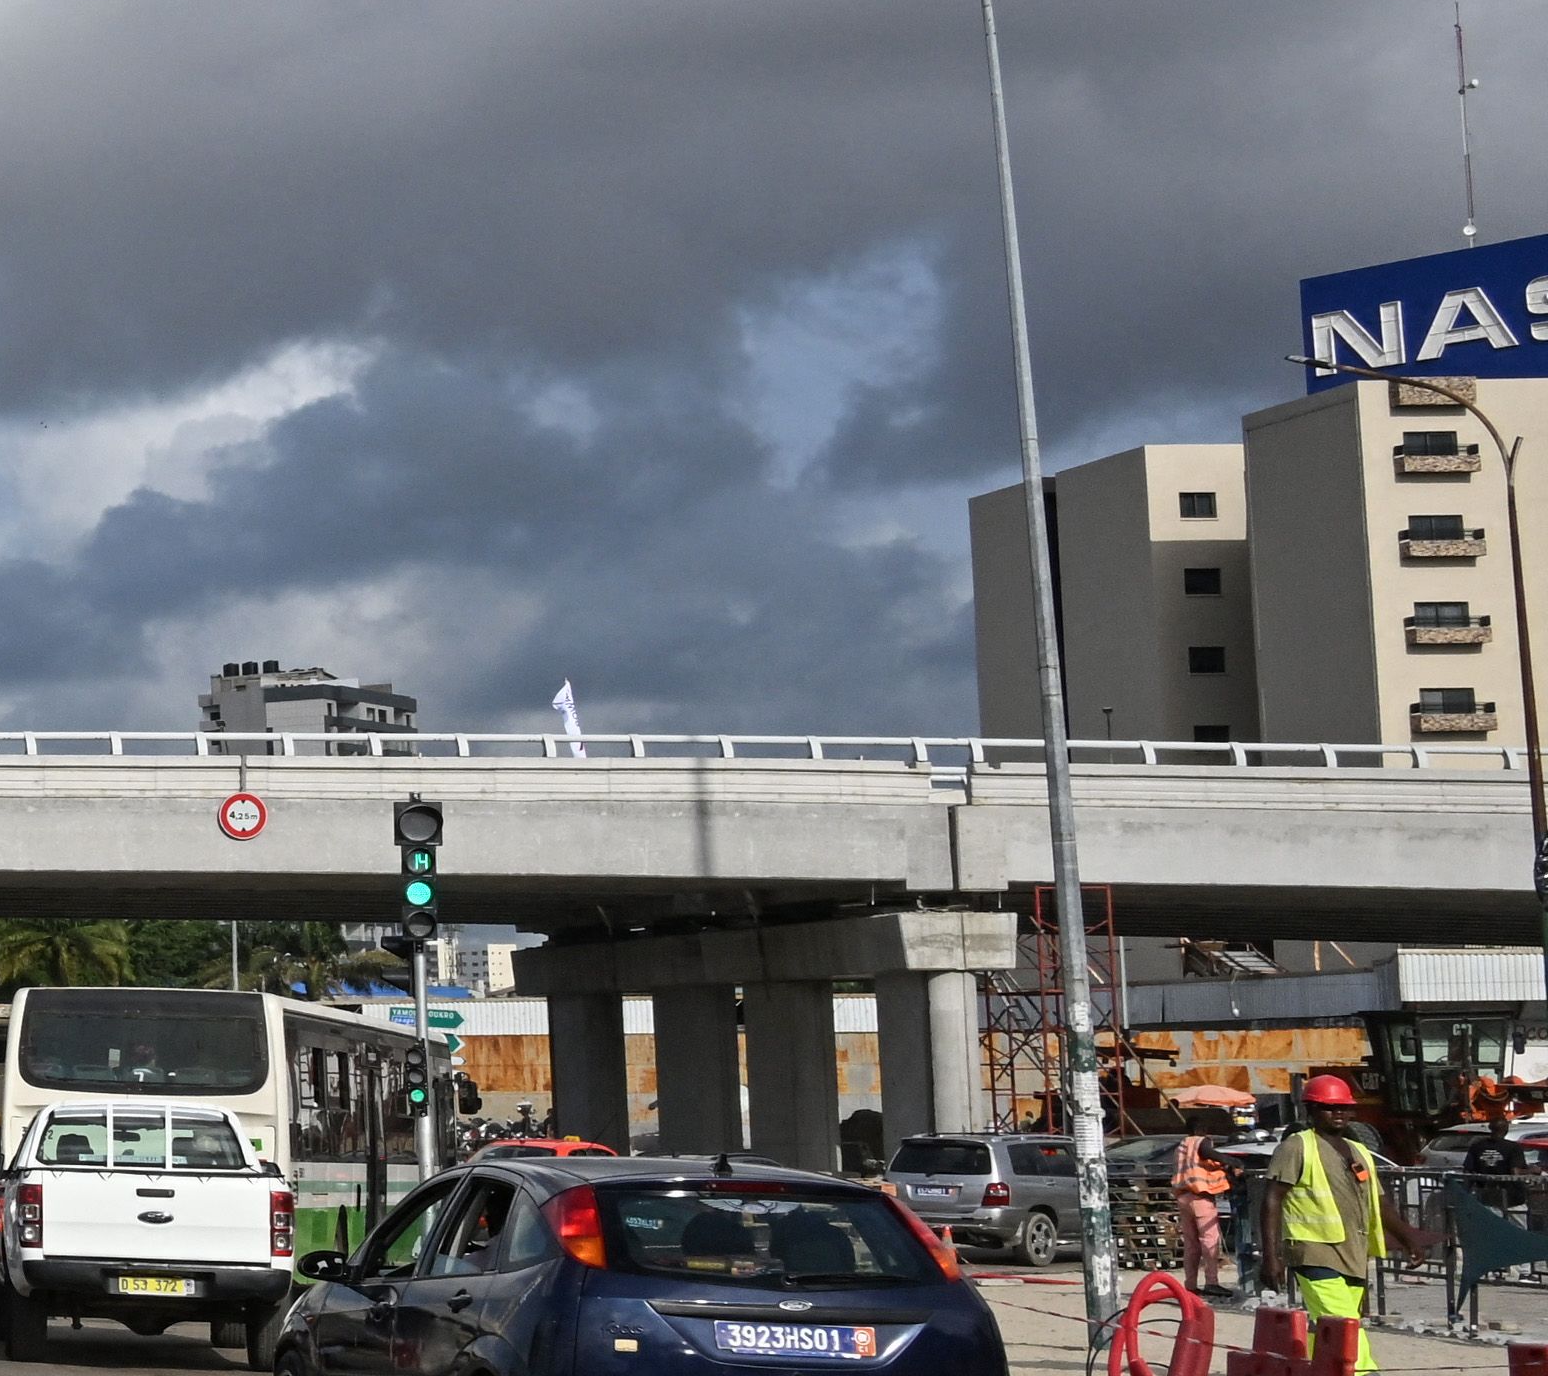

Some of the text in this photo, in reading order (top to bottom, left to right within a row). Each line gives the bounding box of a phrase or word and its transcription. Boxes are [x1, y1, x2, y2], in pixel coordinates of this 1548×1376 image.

[414, 853, 429, 870] 14
[133, 1279, 148, 1291] 53
[155, 1280, 178, 1292] 372
[727, 1324, 840, 1352] 3923HS01
